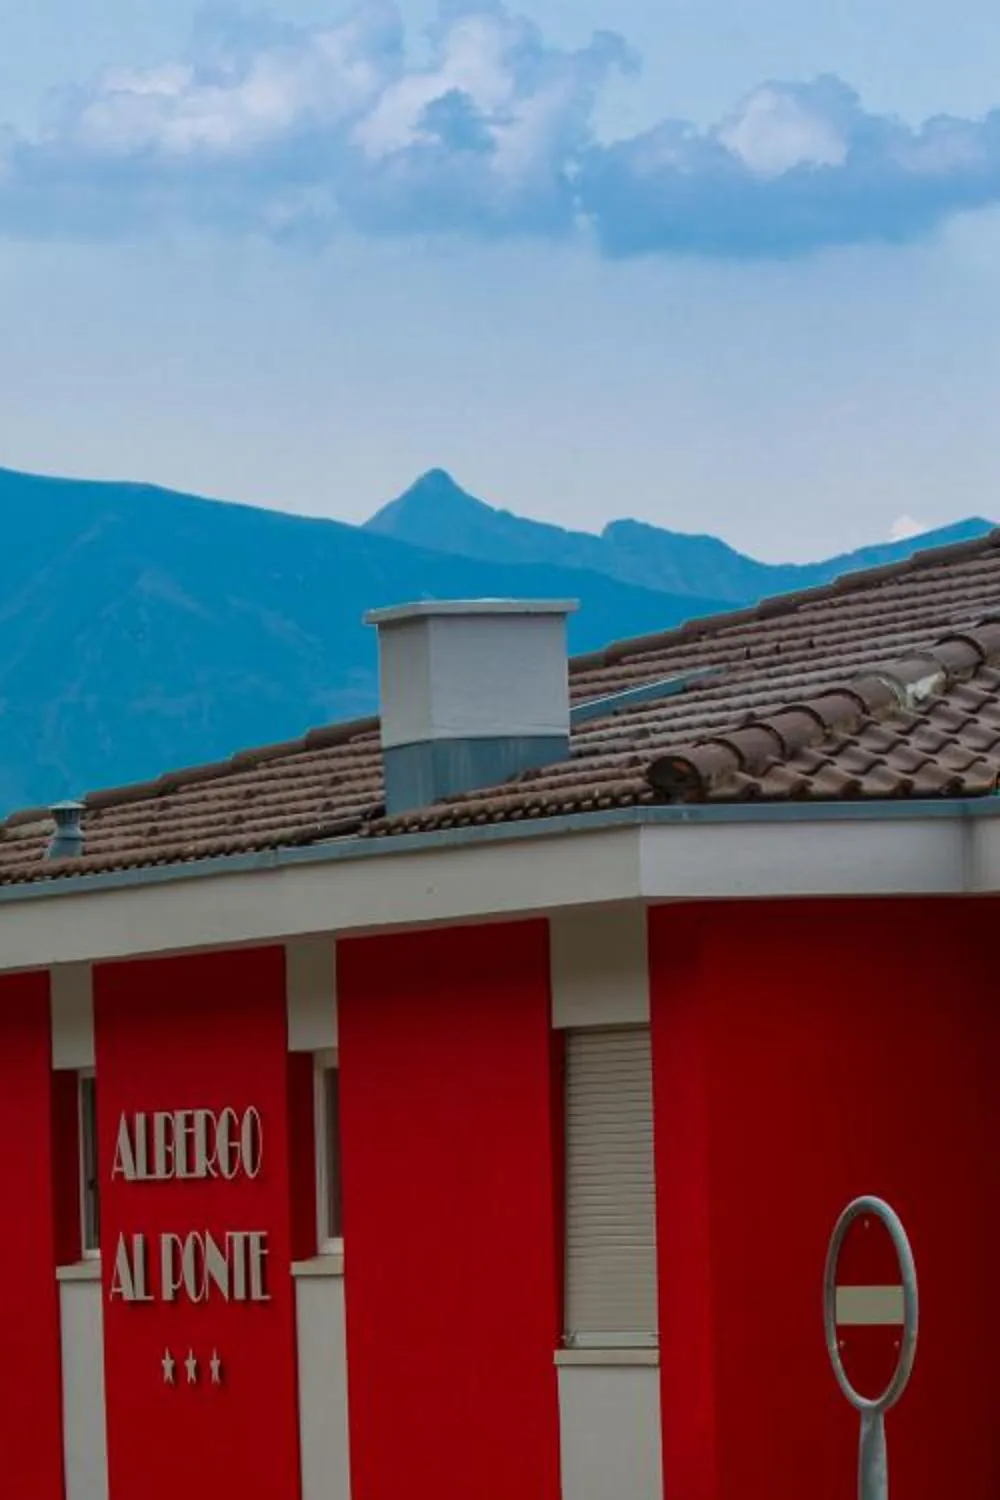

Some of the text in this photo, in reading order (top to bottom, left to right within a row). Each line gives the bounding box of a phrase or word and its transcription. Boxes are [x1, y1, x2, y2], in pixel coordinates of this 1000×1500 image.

[112, 1105, 263, 1181] ALBERGO
[109, 1229, 272, 1303] AL PONTE
